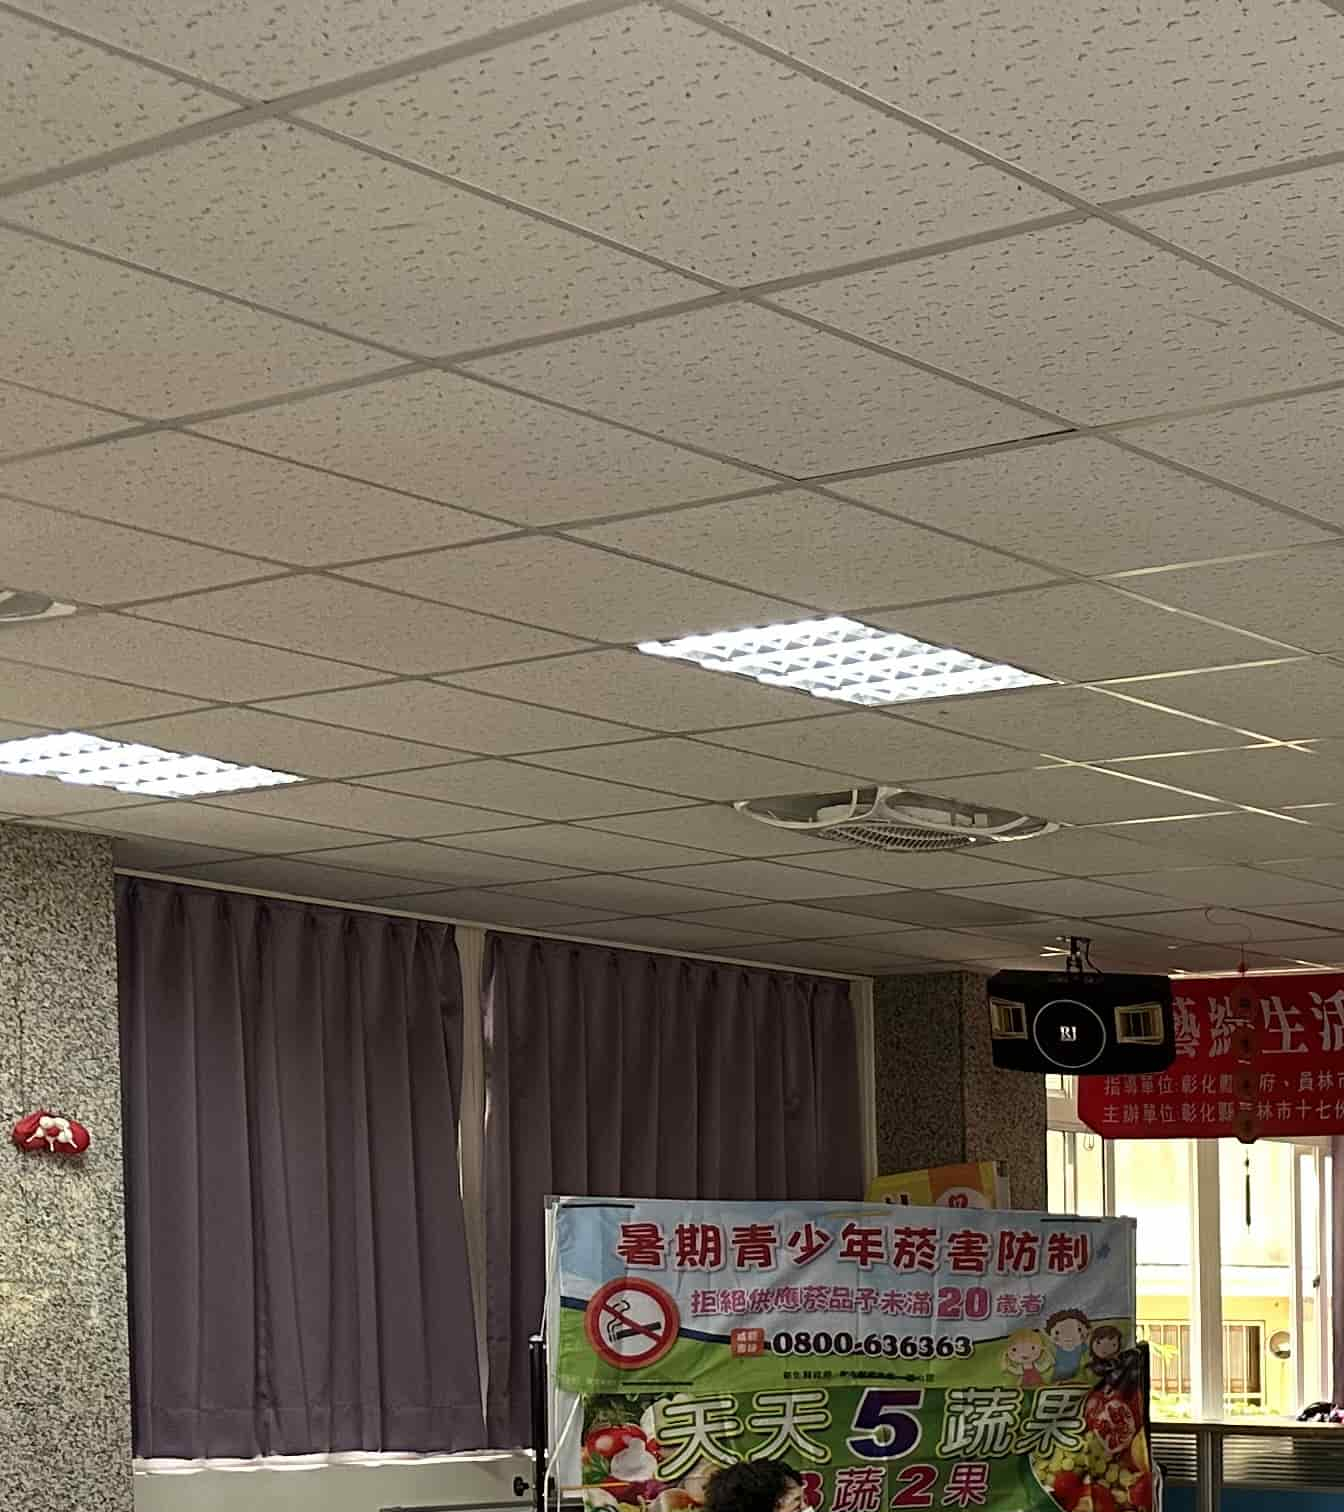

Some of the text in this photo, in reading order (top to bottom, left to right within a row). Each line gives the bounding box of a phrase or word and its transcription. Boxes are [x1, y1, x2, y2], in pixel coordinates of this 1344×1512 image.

[616, 1222, 1093, 1275] 暑期青少年菸害防制
[772, 1331, 973, 1359] 0800-636363
